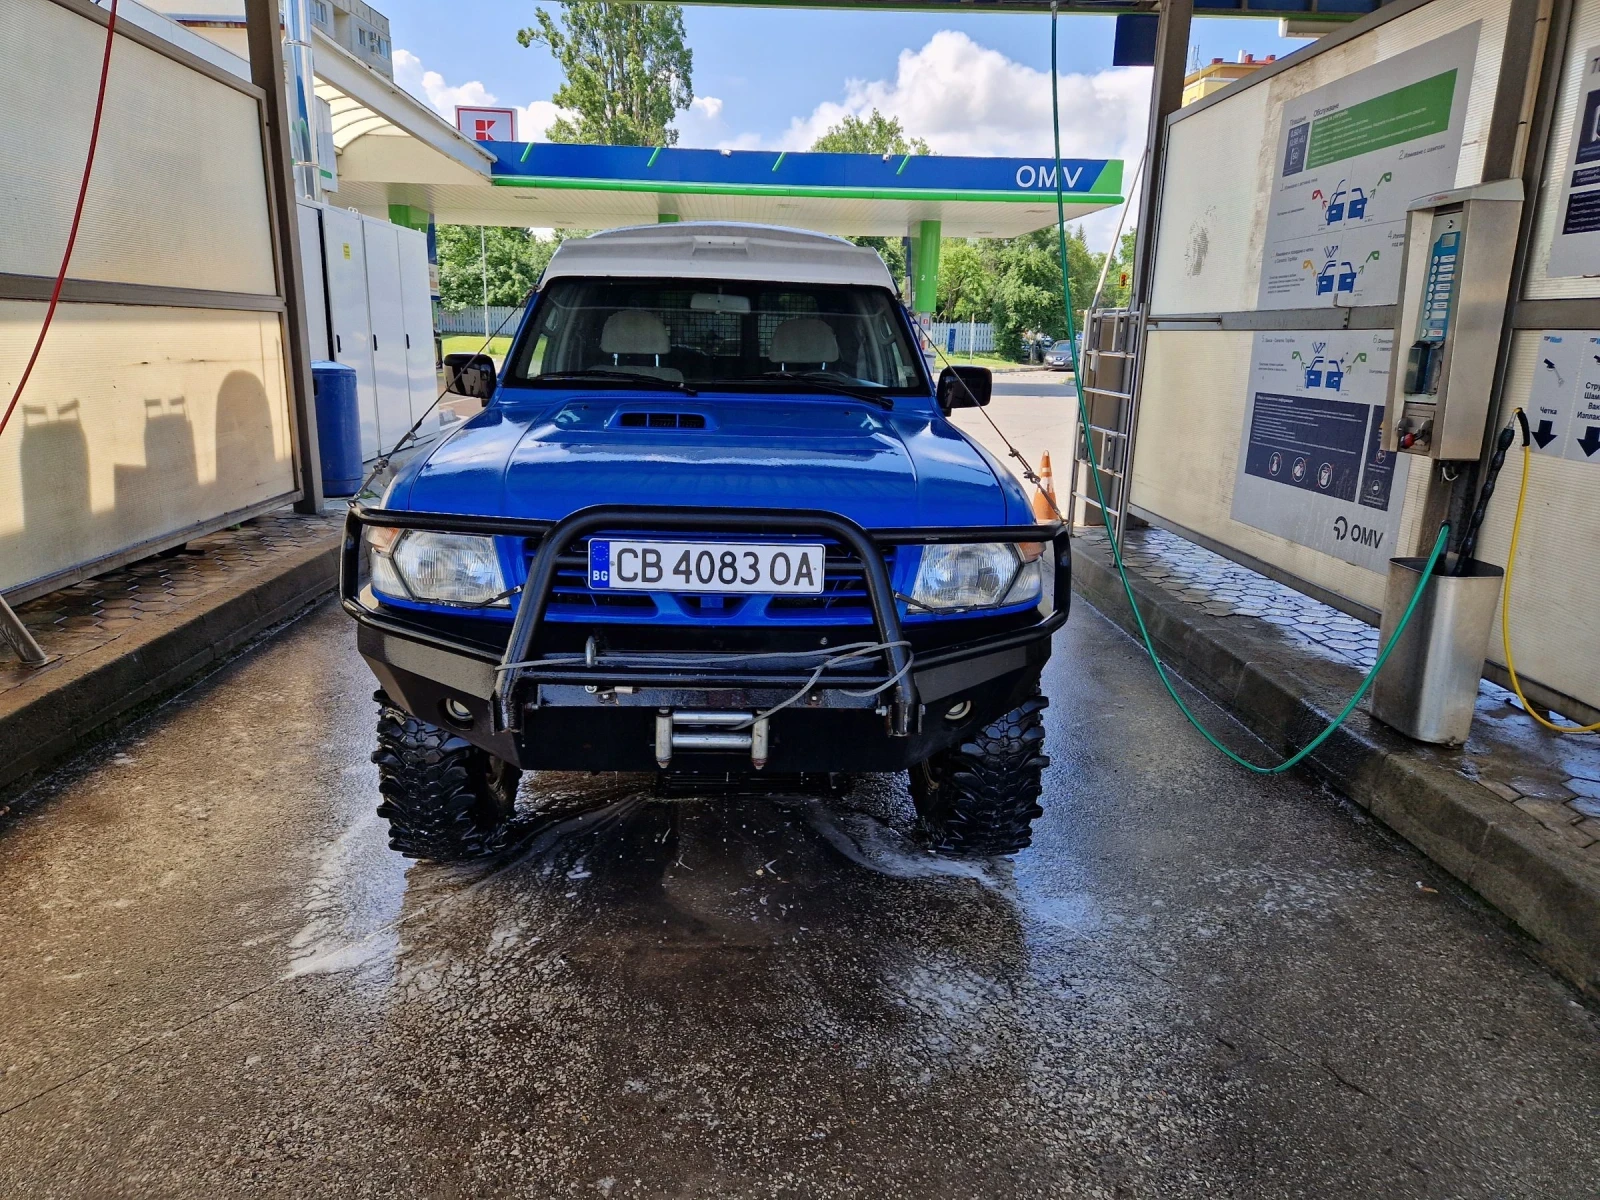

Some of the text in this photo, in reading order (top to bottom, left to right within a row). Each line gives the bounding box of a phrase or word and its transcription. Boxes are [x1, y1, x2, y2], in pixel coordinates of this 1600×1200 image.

[1015, 165, 1084, 189] OMV
[1540, 406, 1557, 415] Четка
[1350, 523, 1384, 549] OMV
[592, 570, 608, 581] BG
[616, 547, 663, 583] CB
[672, 549, 761, 585] 4083
